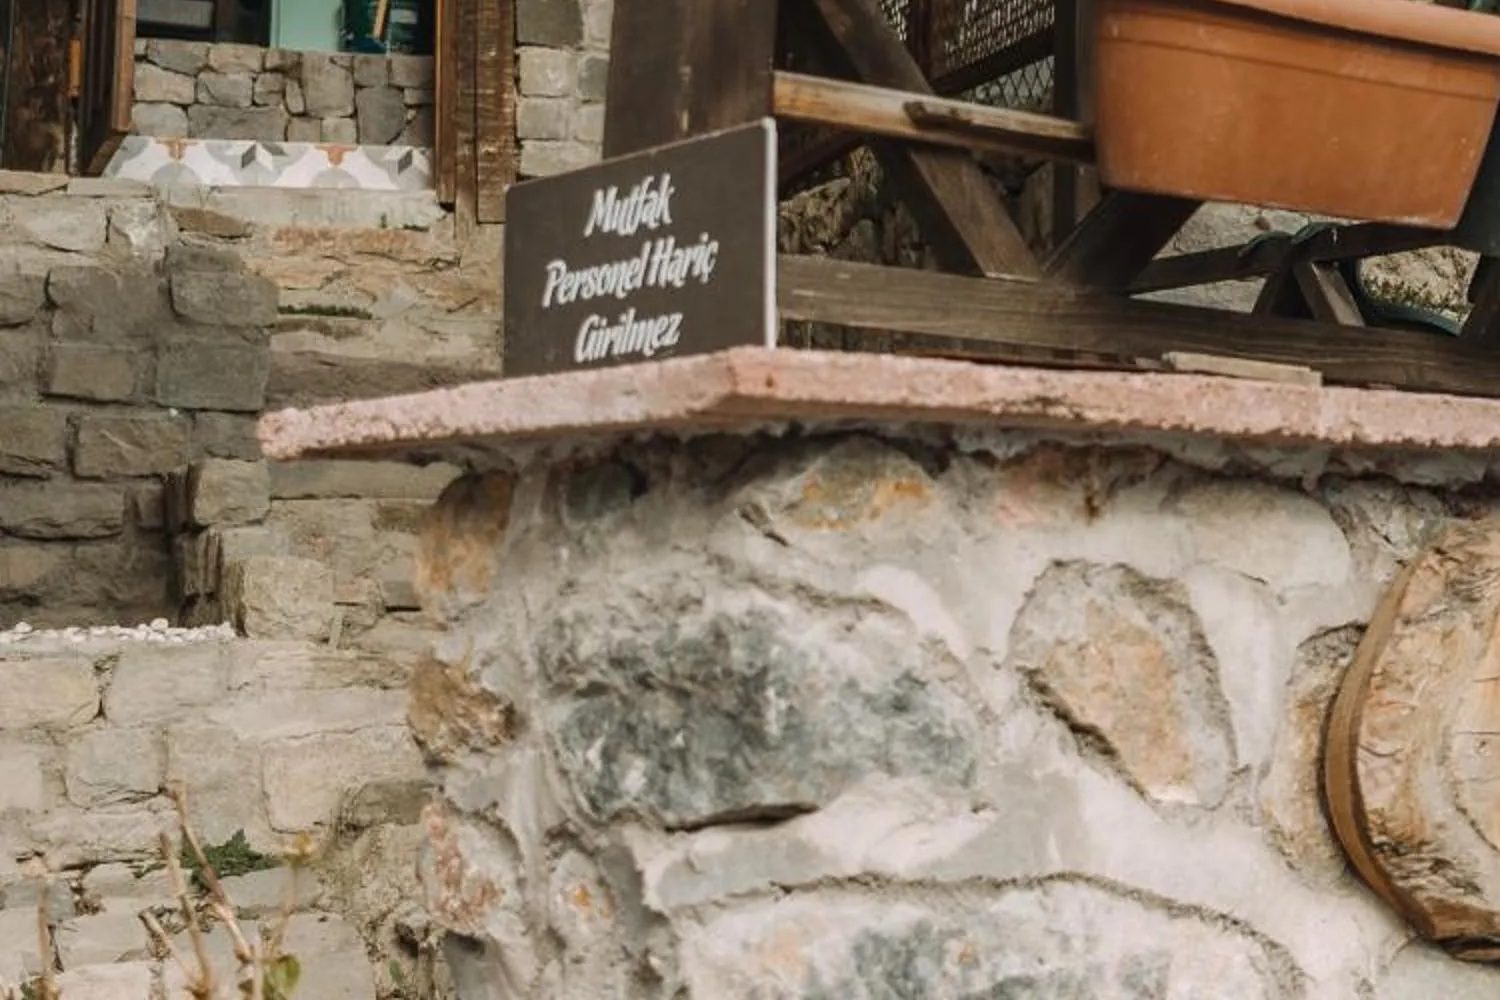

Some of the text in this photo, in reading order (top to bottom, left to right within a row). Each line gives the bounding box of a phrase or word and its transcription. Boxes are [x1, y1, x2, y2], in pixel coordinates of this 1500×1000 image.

[584, 172, 674, 237] Mutfak
[542, 232, 719, 308] Personel Hariç
[574, 307, 683, 363] Girilmez
